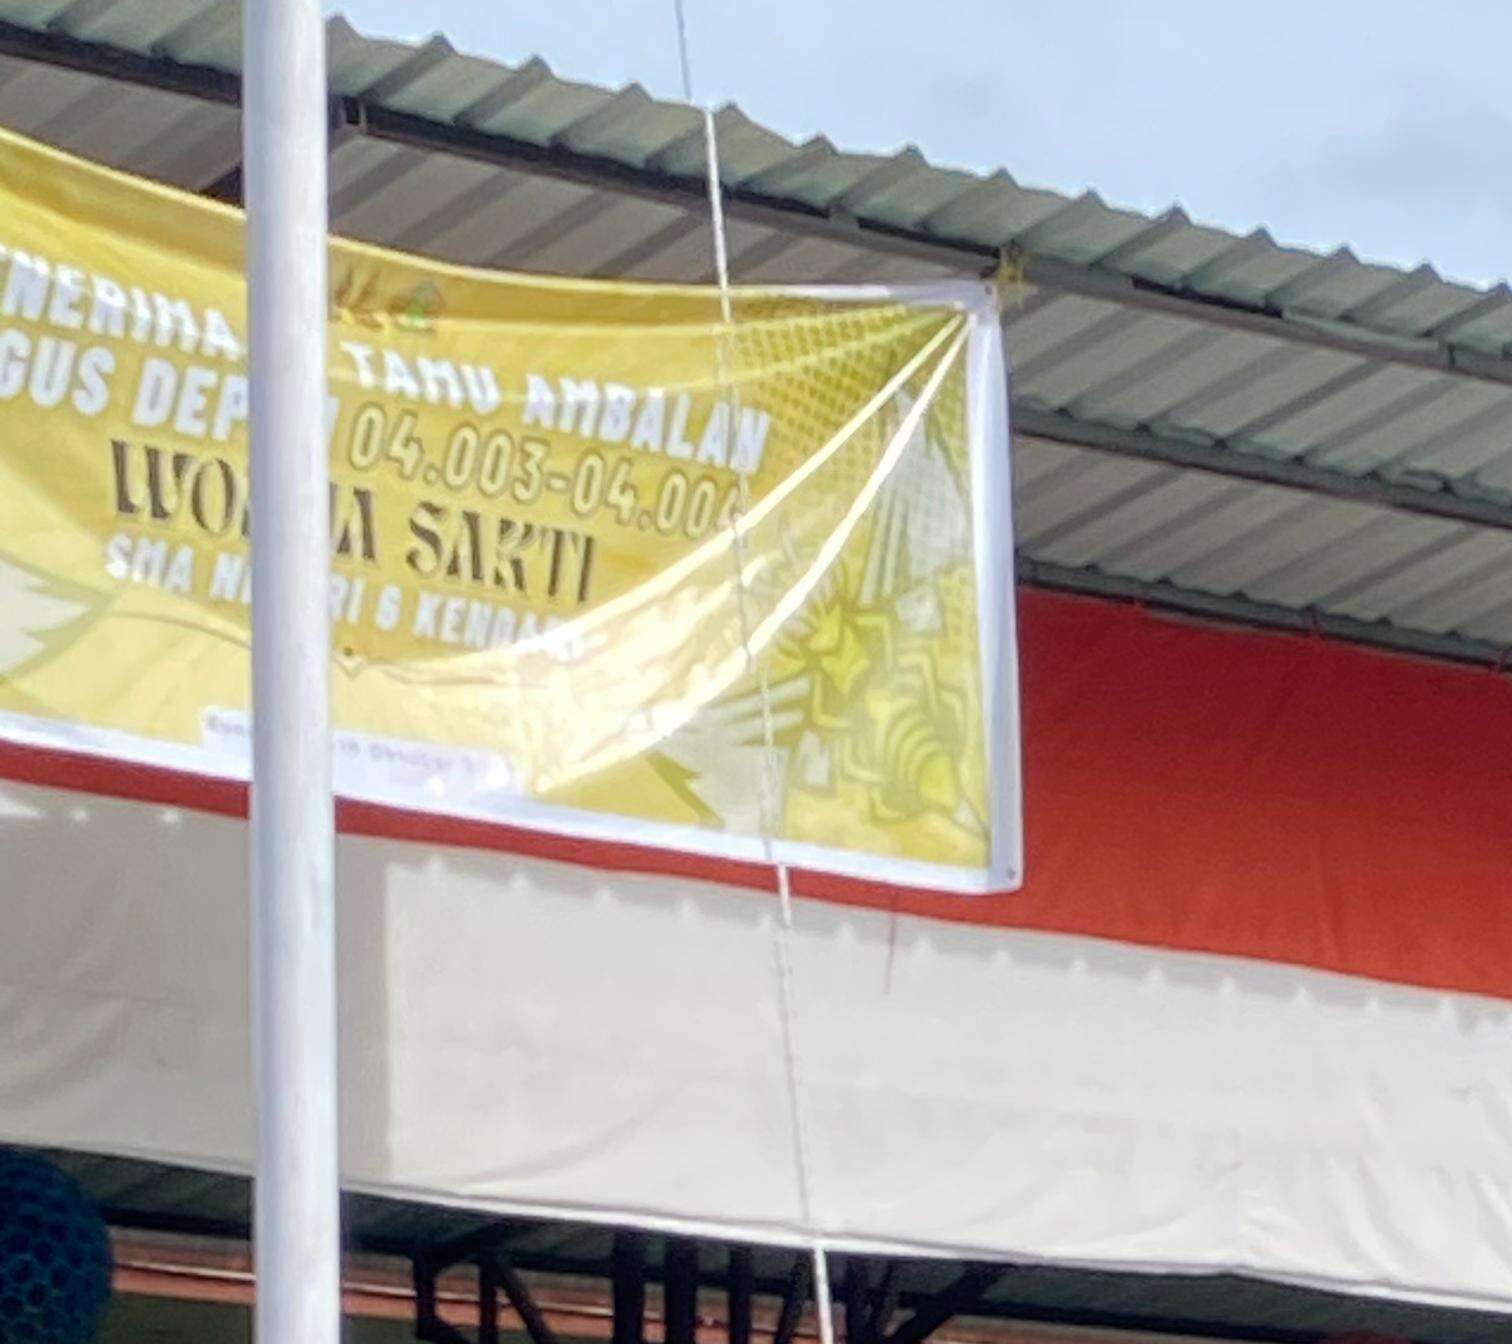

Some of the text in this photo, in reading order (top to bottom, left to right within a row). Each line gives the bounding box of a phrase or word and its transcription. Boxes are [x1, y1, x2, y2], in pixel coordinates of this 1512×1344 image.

[131, 356, 340, 450] DEP
[339, 340, 501, 415] TAMU
[522, 373, 770, 474] AMBALAN
[106, 531, 195, 593] SMA
[374, 584, 402, 631] 6
[404, 499, 596, 604] SAKTI
